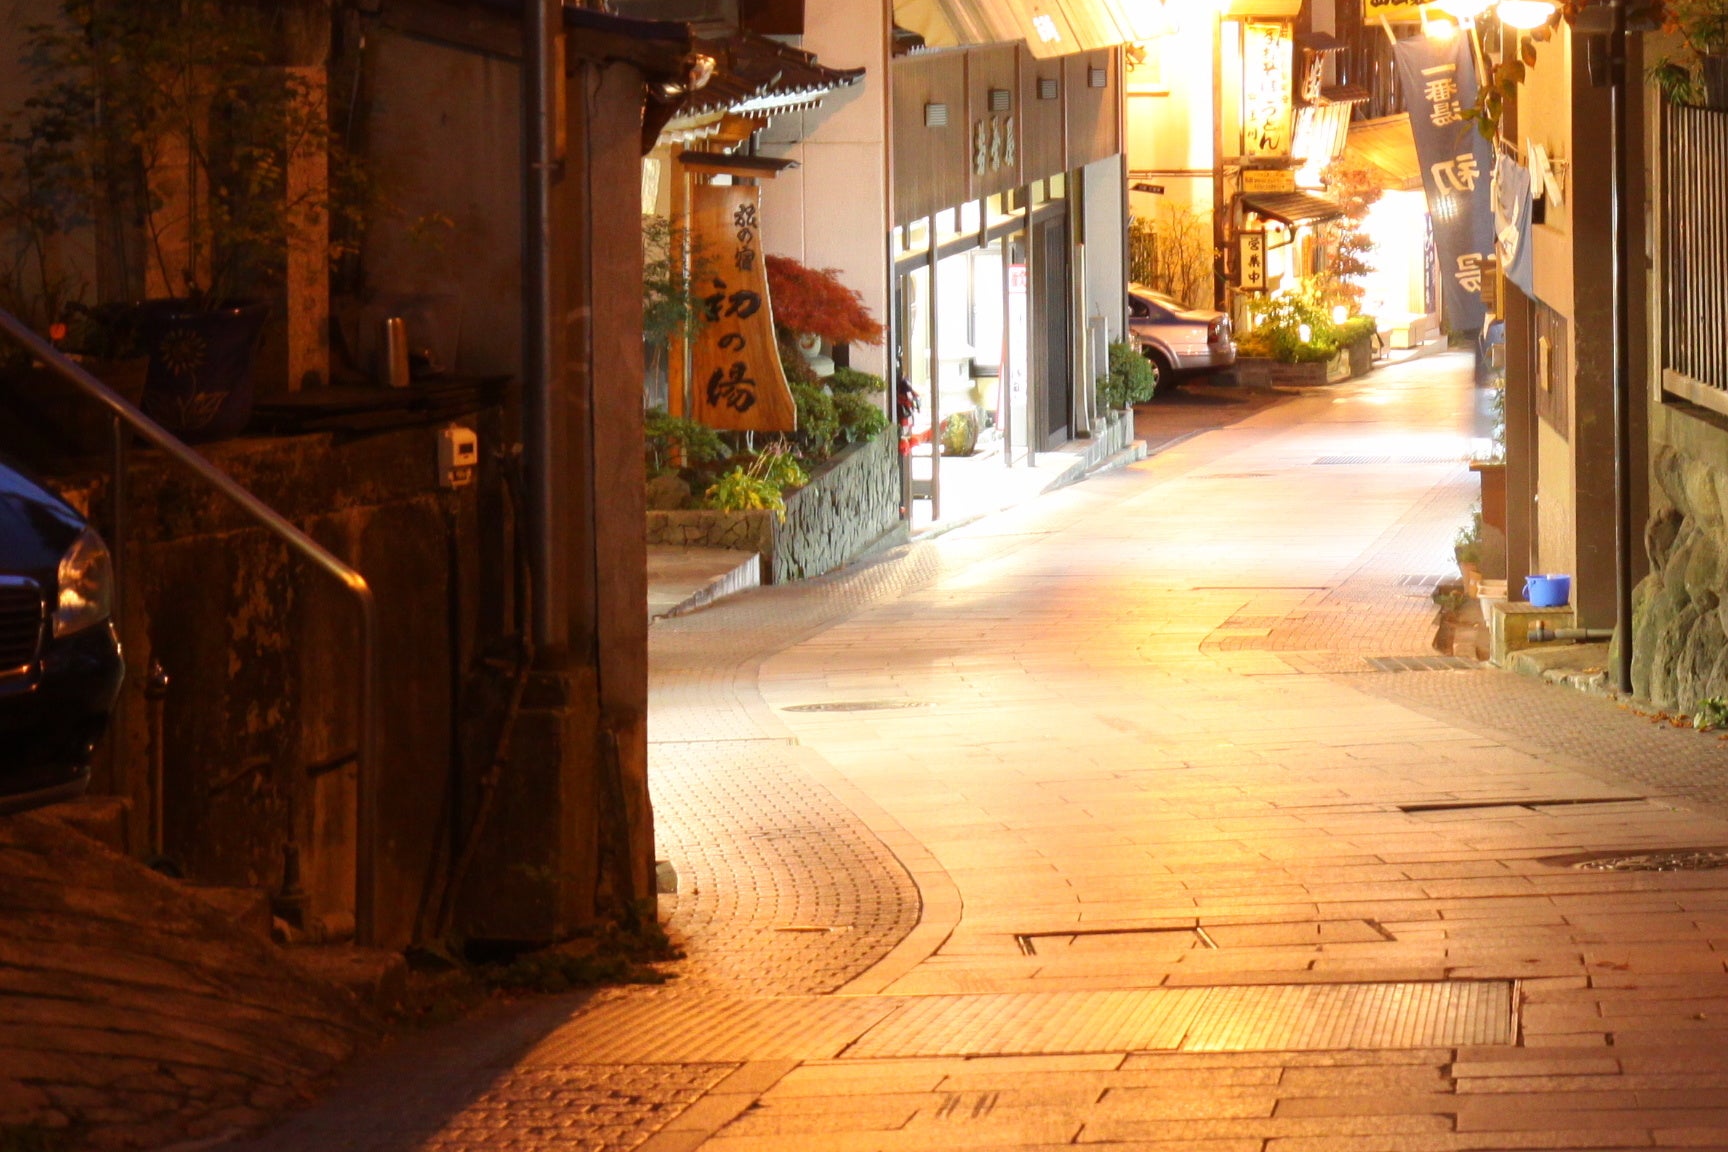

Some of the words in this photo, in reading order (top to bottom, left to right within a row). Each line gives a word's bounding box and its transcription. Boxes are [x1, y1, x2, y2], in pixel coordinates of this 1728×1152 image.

[1248, 237, 1261, 285] 営業中
[704, 278, 763, 414] 初の湯
